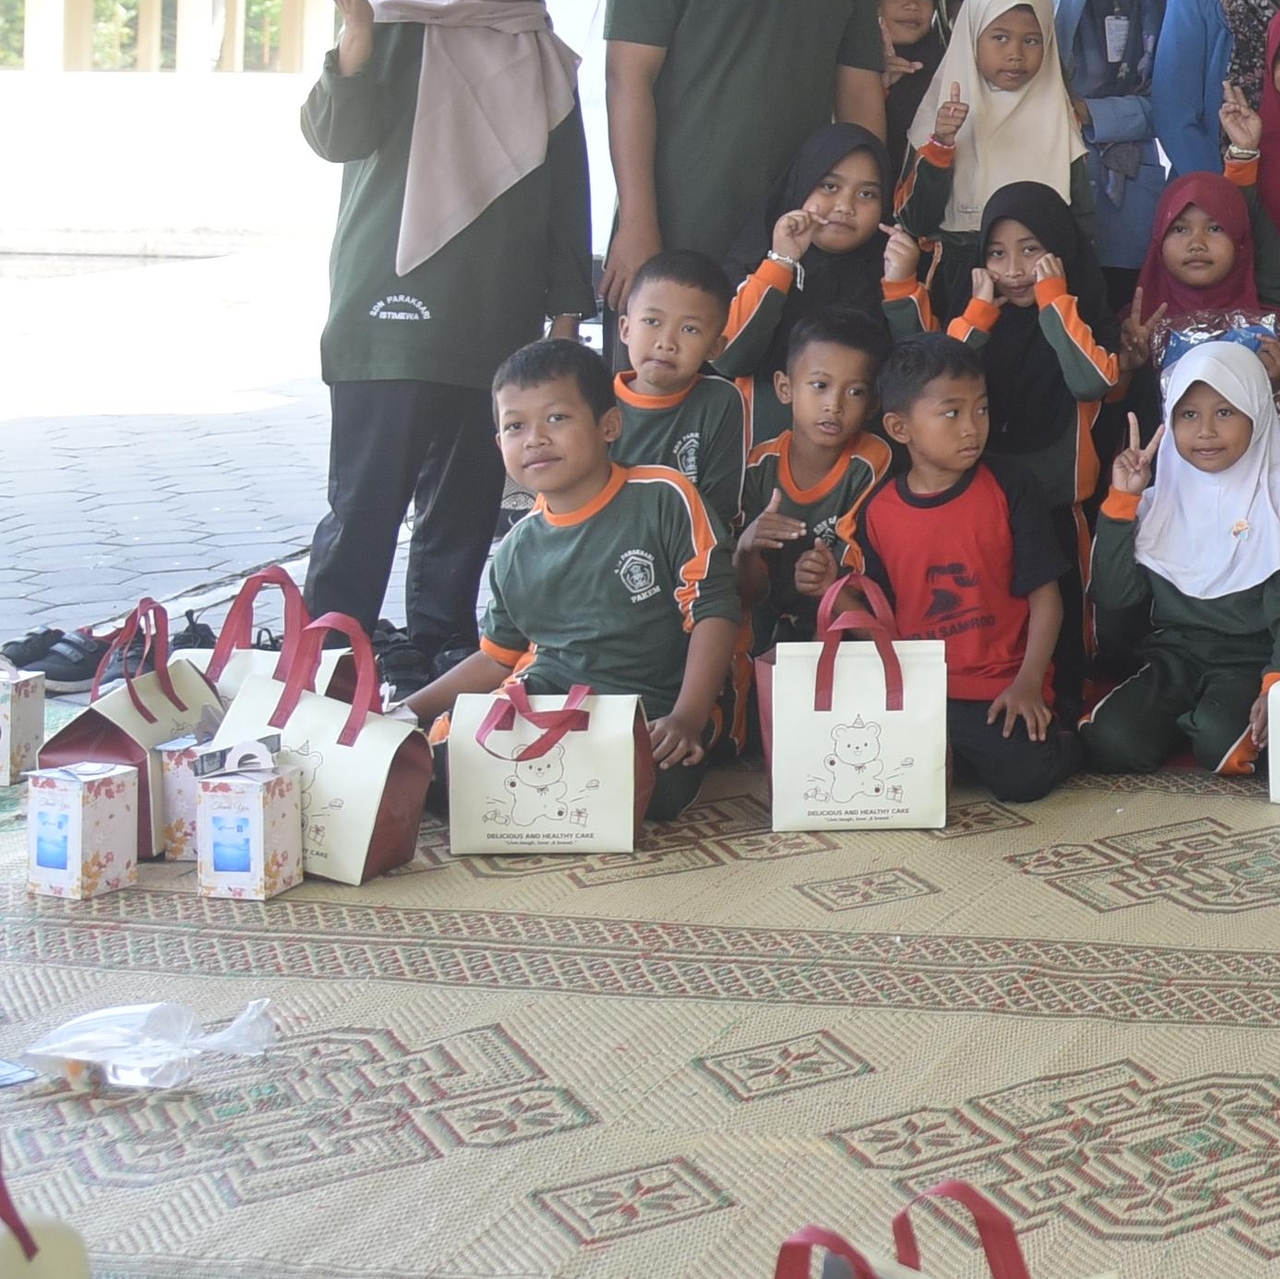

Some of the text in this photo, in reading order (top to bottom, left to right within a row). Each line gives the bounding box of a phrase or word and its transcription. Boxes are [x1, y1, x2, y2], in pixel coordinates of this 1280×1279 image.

[369, 294, 431, 320] SDN PARAKSARI
[379, 311, 419, 320] ISTIMEWA
[630, 585, 662, 603] PAKEM
